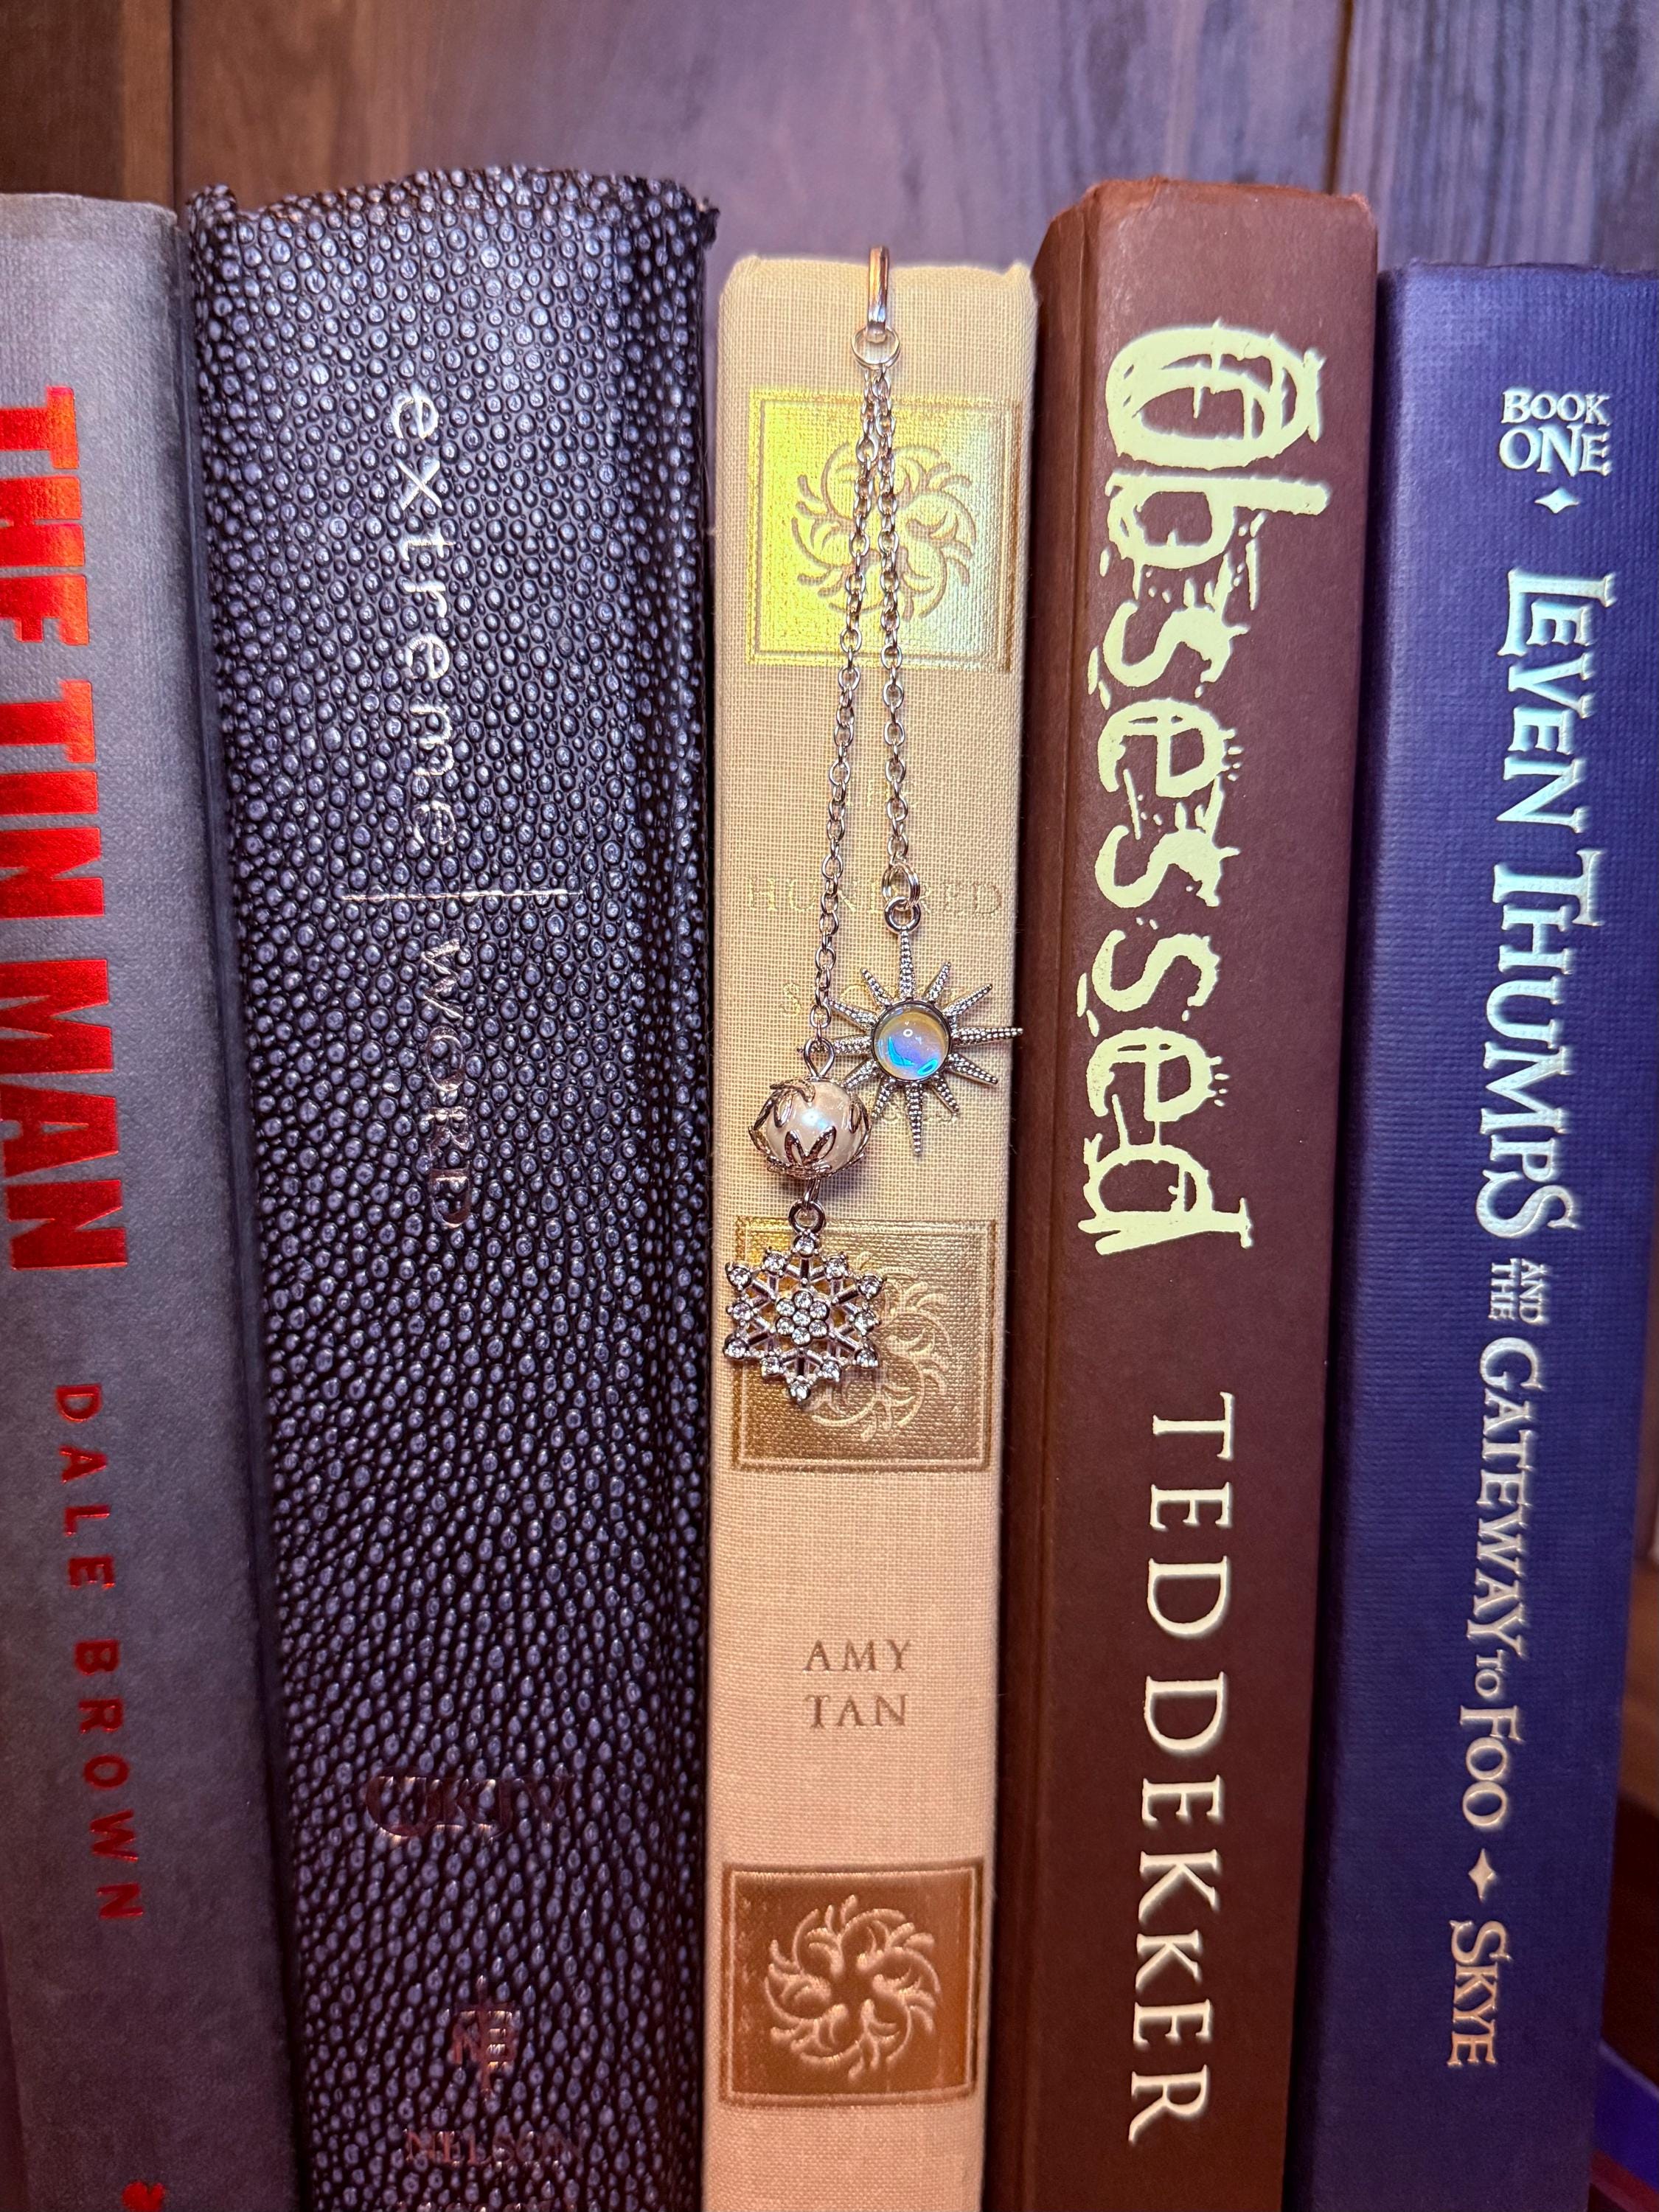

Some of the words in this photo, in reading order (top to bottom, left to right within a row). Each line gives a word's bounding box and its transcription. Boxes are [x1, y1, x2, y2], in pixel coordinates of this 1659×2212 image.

[0, 386, 89, 645] THE
[1498, 423, 1613, 476] ONE
[1500, 387, 1611, 426] BOOK
[391, 382, 457, 846] extreme
[1497, 567, 1617, 834] LEVEN
[0, 679, 105, 919] TIN
[1078, 320, 1330, 1255] Obsessed
[0, 959, 128, 1270] MAN
[420, 938, 473, 1230] WORD
[1476, 848, 1604, 1239] THUMPS
[1488, 1258, 1517, 1321] THE
[1519, 1258, 1550, 1324] AND
[55, 1383, 116, 1589] DALE
[1147, 1391, 1235, 1638] TED
[1467, 1337, 1547, 1658] GATEWAY
[802, 1638, 911, 1672] AMY
[805, 1694, 909, 1729] TAN
[1459, 1705, 1524, 1830] FOO
[1475, 1649, 1506, 1698] TO
[74, 1639, 144, 1919] BROWN
[1128, 1672, 1228, 2146] DEKKER
[1447, 1919, 1513, 2067] SKYE
[404, 2129, 588, 2166] NELSON
